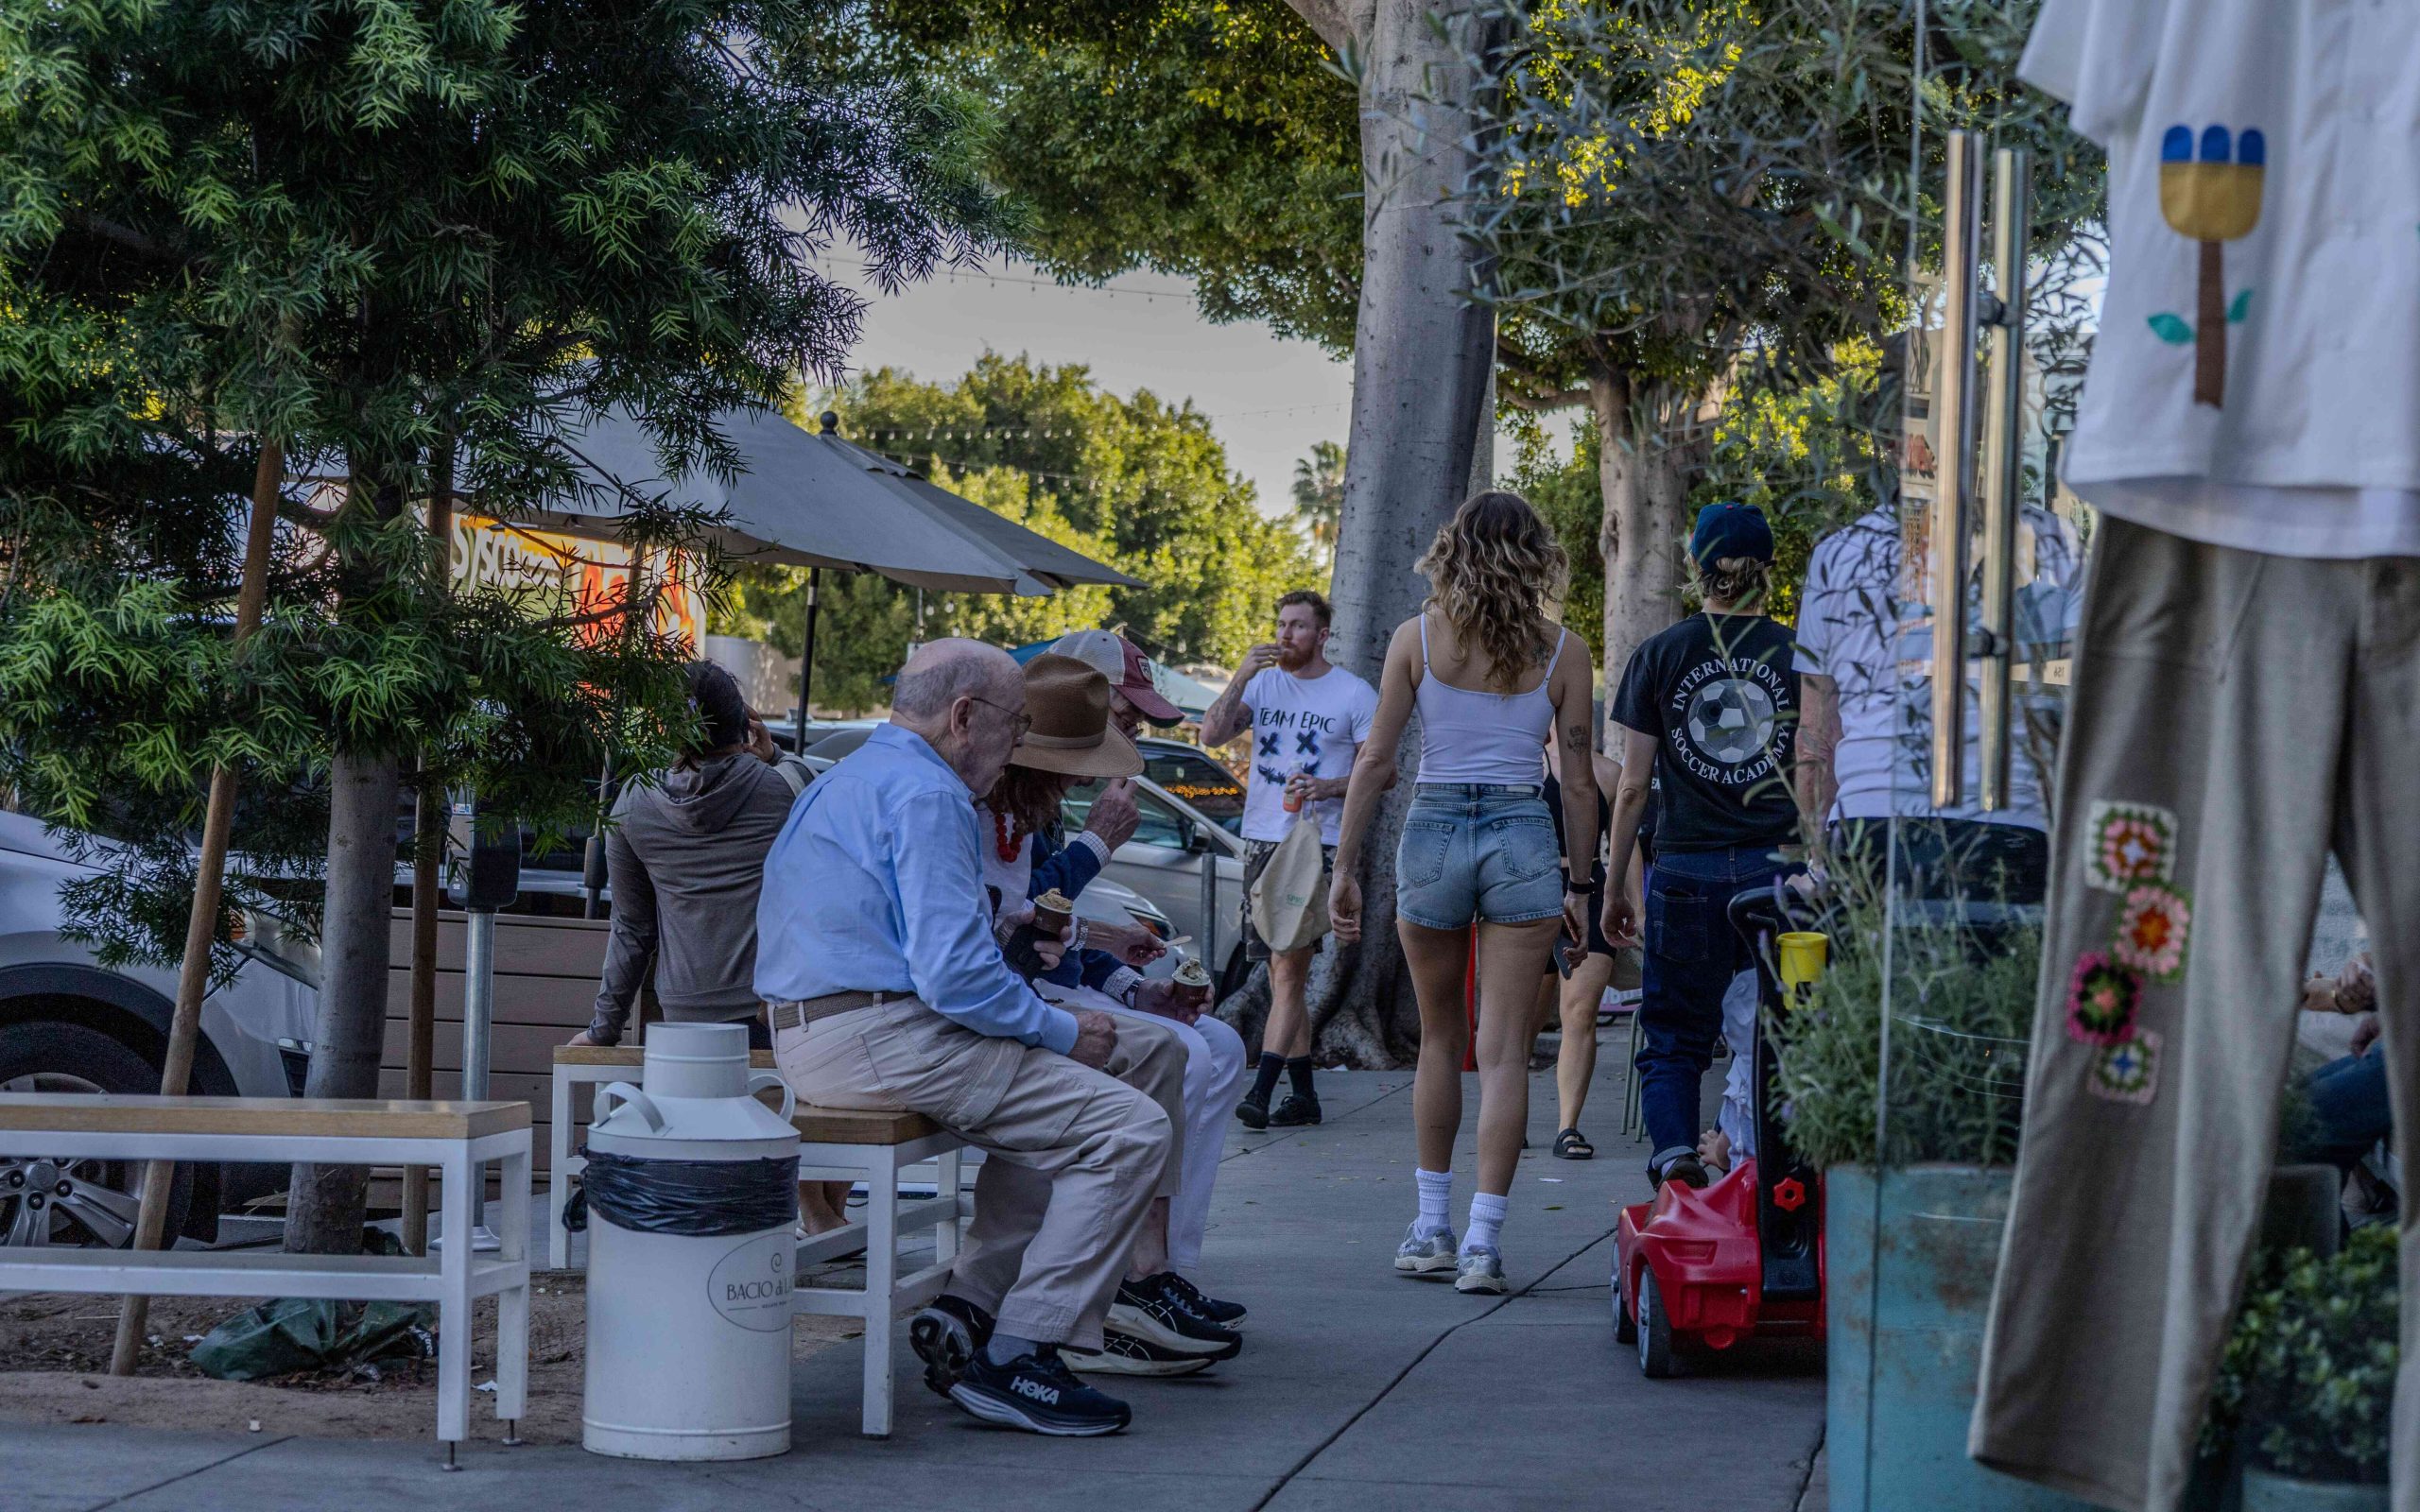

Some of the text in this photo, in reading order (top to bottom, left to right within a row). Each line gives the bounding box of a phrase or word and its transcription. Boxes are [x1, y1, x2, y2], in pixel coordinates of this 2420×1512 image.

[1672, 658, 1789, 712] INTERNATIONAL
[1259, 708, 1337, 734] TEAM EPIC
[1671, 728, 1720, 782] SOCCER
[727, 1280, 773, 1301] BACIO
[1011, 1375, 1060, 1405] HOKA
